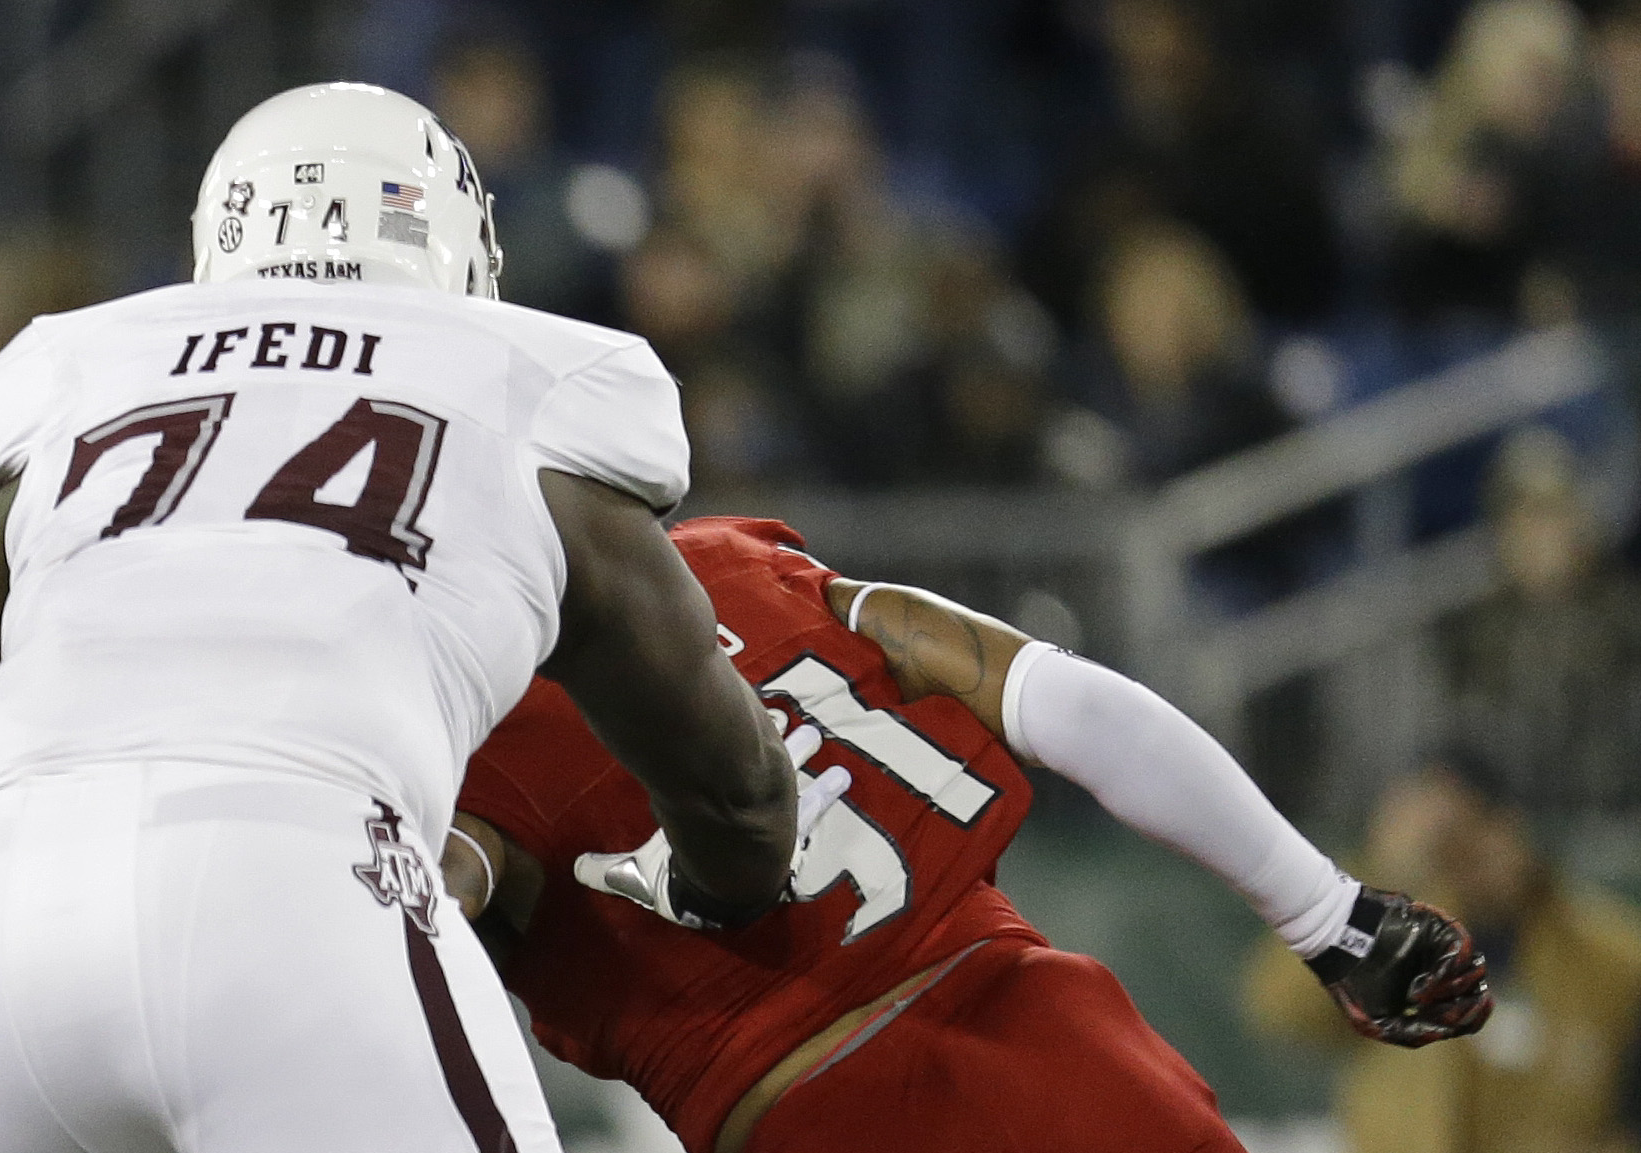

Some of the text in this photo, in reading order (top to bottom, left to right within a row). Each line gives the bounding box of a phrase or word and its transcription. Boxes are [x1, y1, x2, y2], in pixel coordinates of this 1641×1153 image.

[324, 261, 363, 281] A&M
[169, 322, 382, 377] IFEDI
[54, 392, 450, 572] 74
